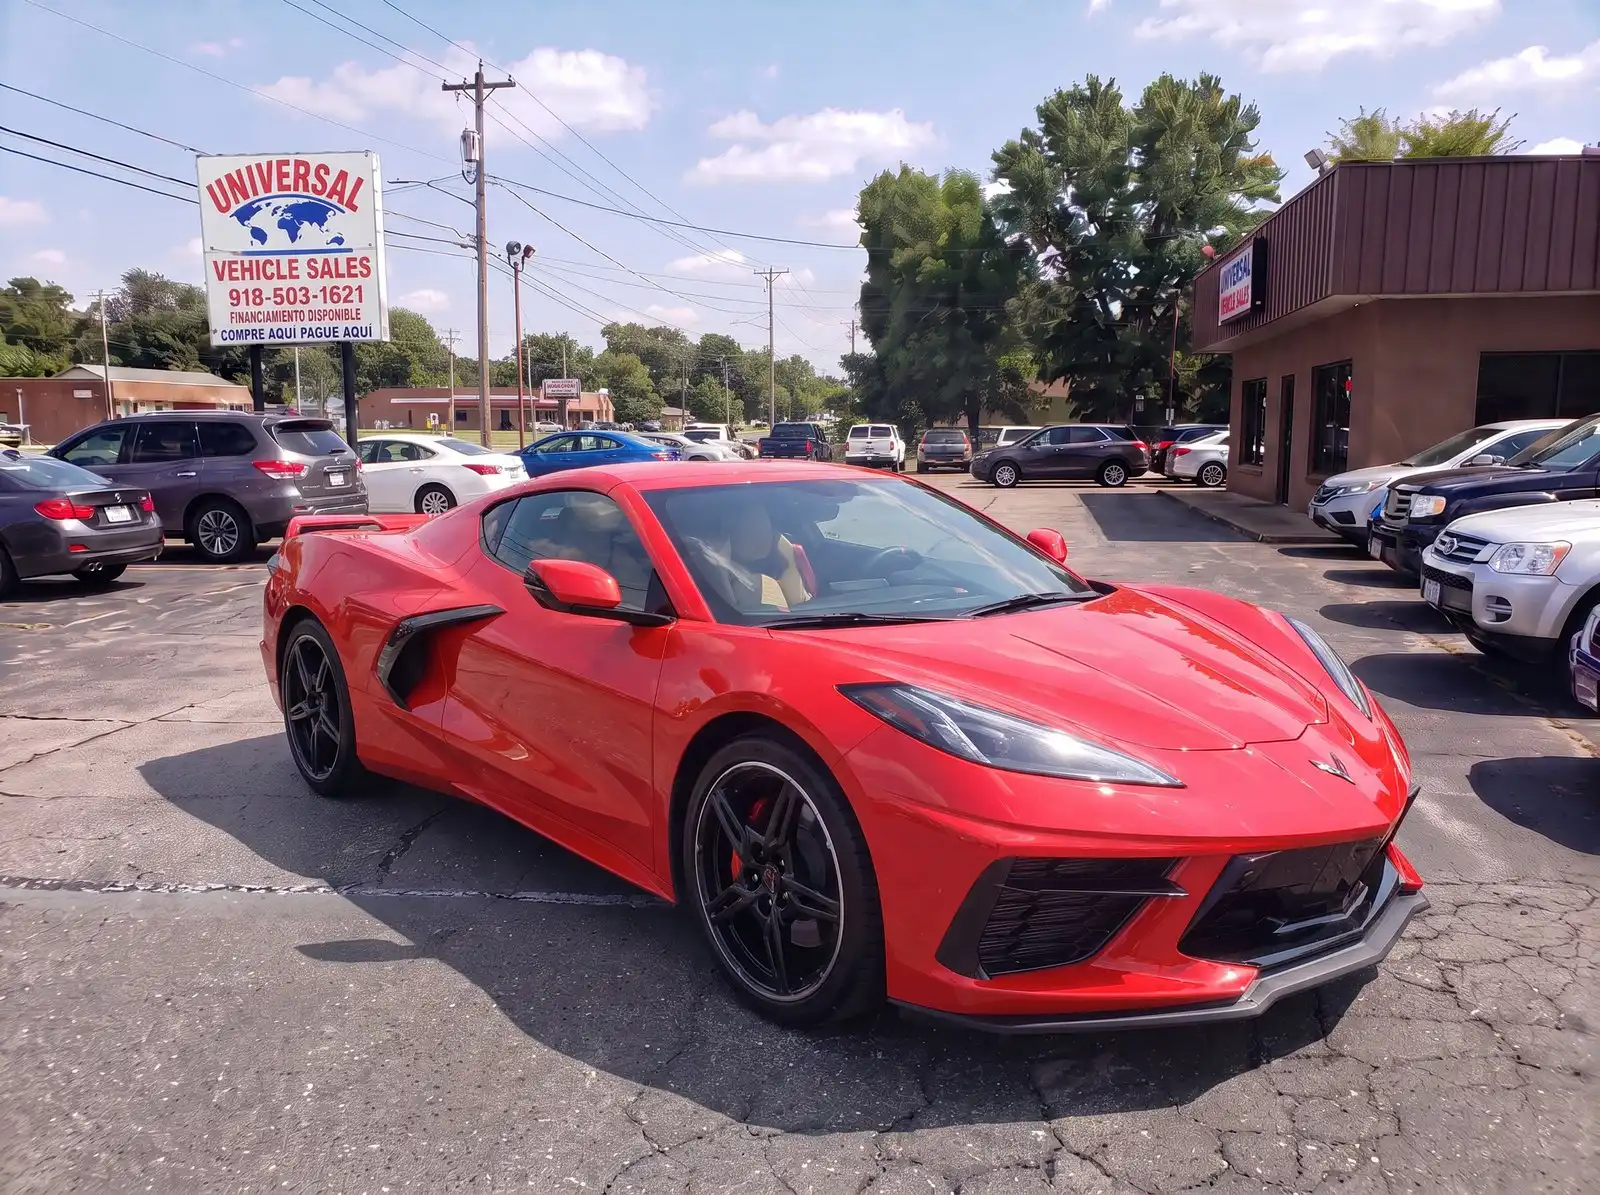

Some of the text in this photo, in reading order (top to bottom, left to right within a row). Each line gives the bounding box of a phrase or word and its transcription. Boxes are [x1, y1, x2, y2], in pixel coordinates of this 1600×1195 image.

[206, 159, 364, 213] UNIVERSAL
[213, 256, 371, 281] VEHICLE SALES
[228, 285, 363, 307] 918-503-1621
[230, 308, 361, 324] FINANCIAMIENTO DISPONIBLE
[221, 327, 265, 341] COMPRE
[300, 326, 339, 338] PAGUE
